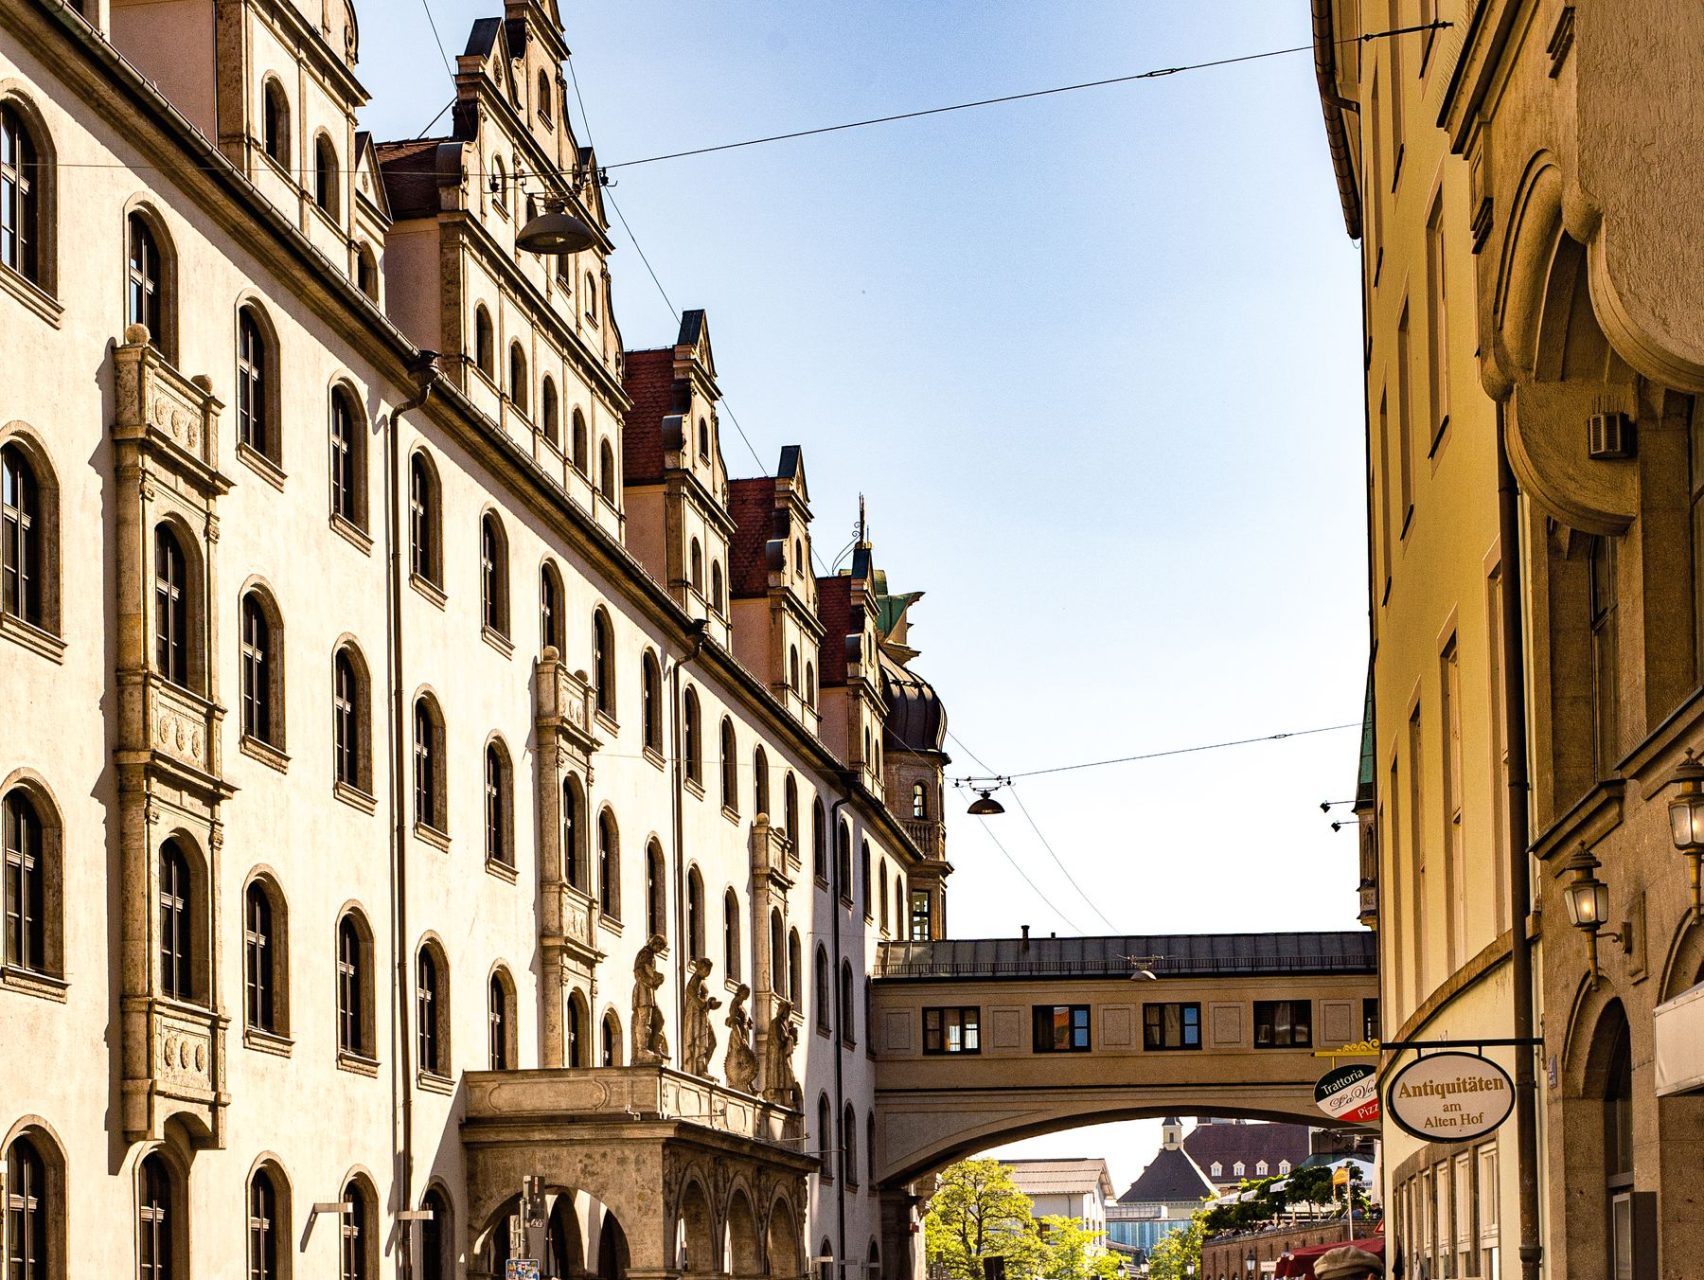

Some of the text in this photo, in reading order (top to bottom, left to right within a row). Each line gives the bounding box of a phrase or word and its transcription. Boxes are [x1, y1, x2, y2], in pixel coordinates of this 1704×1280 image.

[1321, 1069, 1364, 1095] Trattoria
[1398, 1076, 1504, 1099] Antiquitäten
[1330, 1079, 1376, 1111] La Va
[1443, 1103, 1462, 1112] am
[1424, 1113, 1484, 1128] Alten Hof
